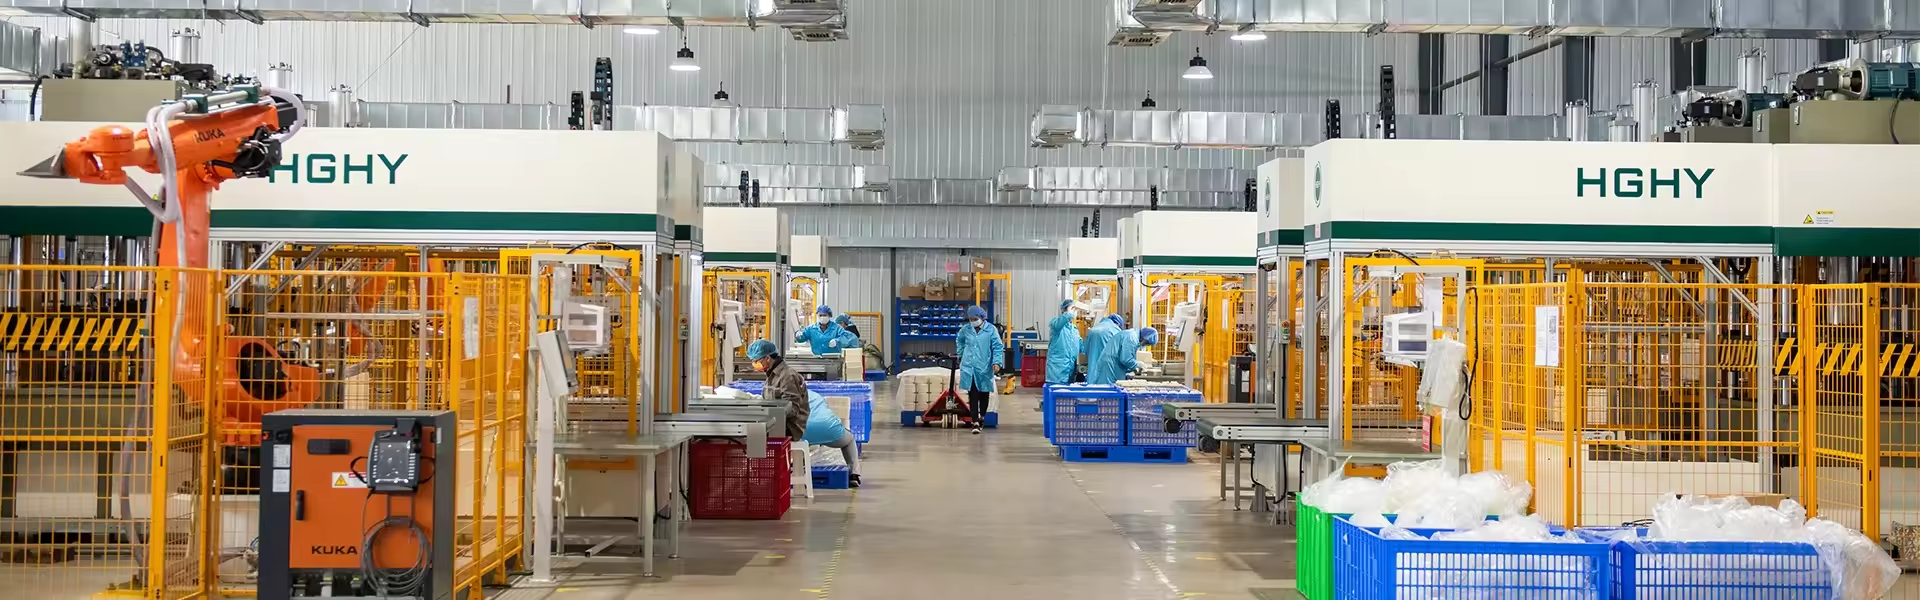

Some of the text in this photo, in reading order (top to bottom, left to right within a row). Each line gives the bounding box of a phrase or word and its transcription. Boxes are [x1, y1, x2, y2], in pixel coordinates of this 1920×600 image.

[194, 128, 226, 143] KUKA
[269, 153, 409, 184] HGHY
[1577, 167, 1716, 199] HGHY
[311, 545, 358, 554] KUKA
